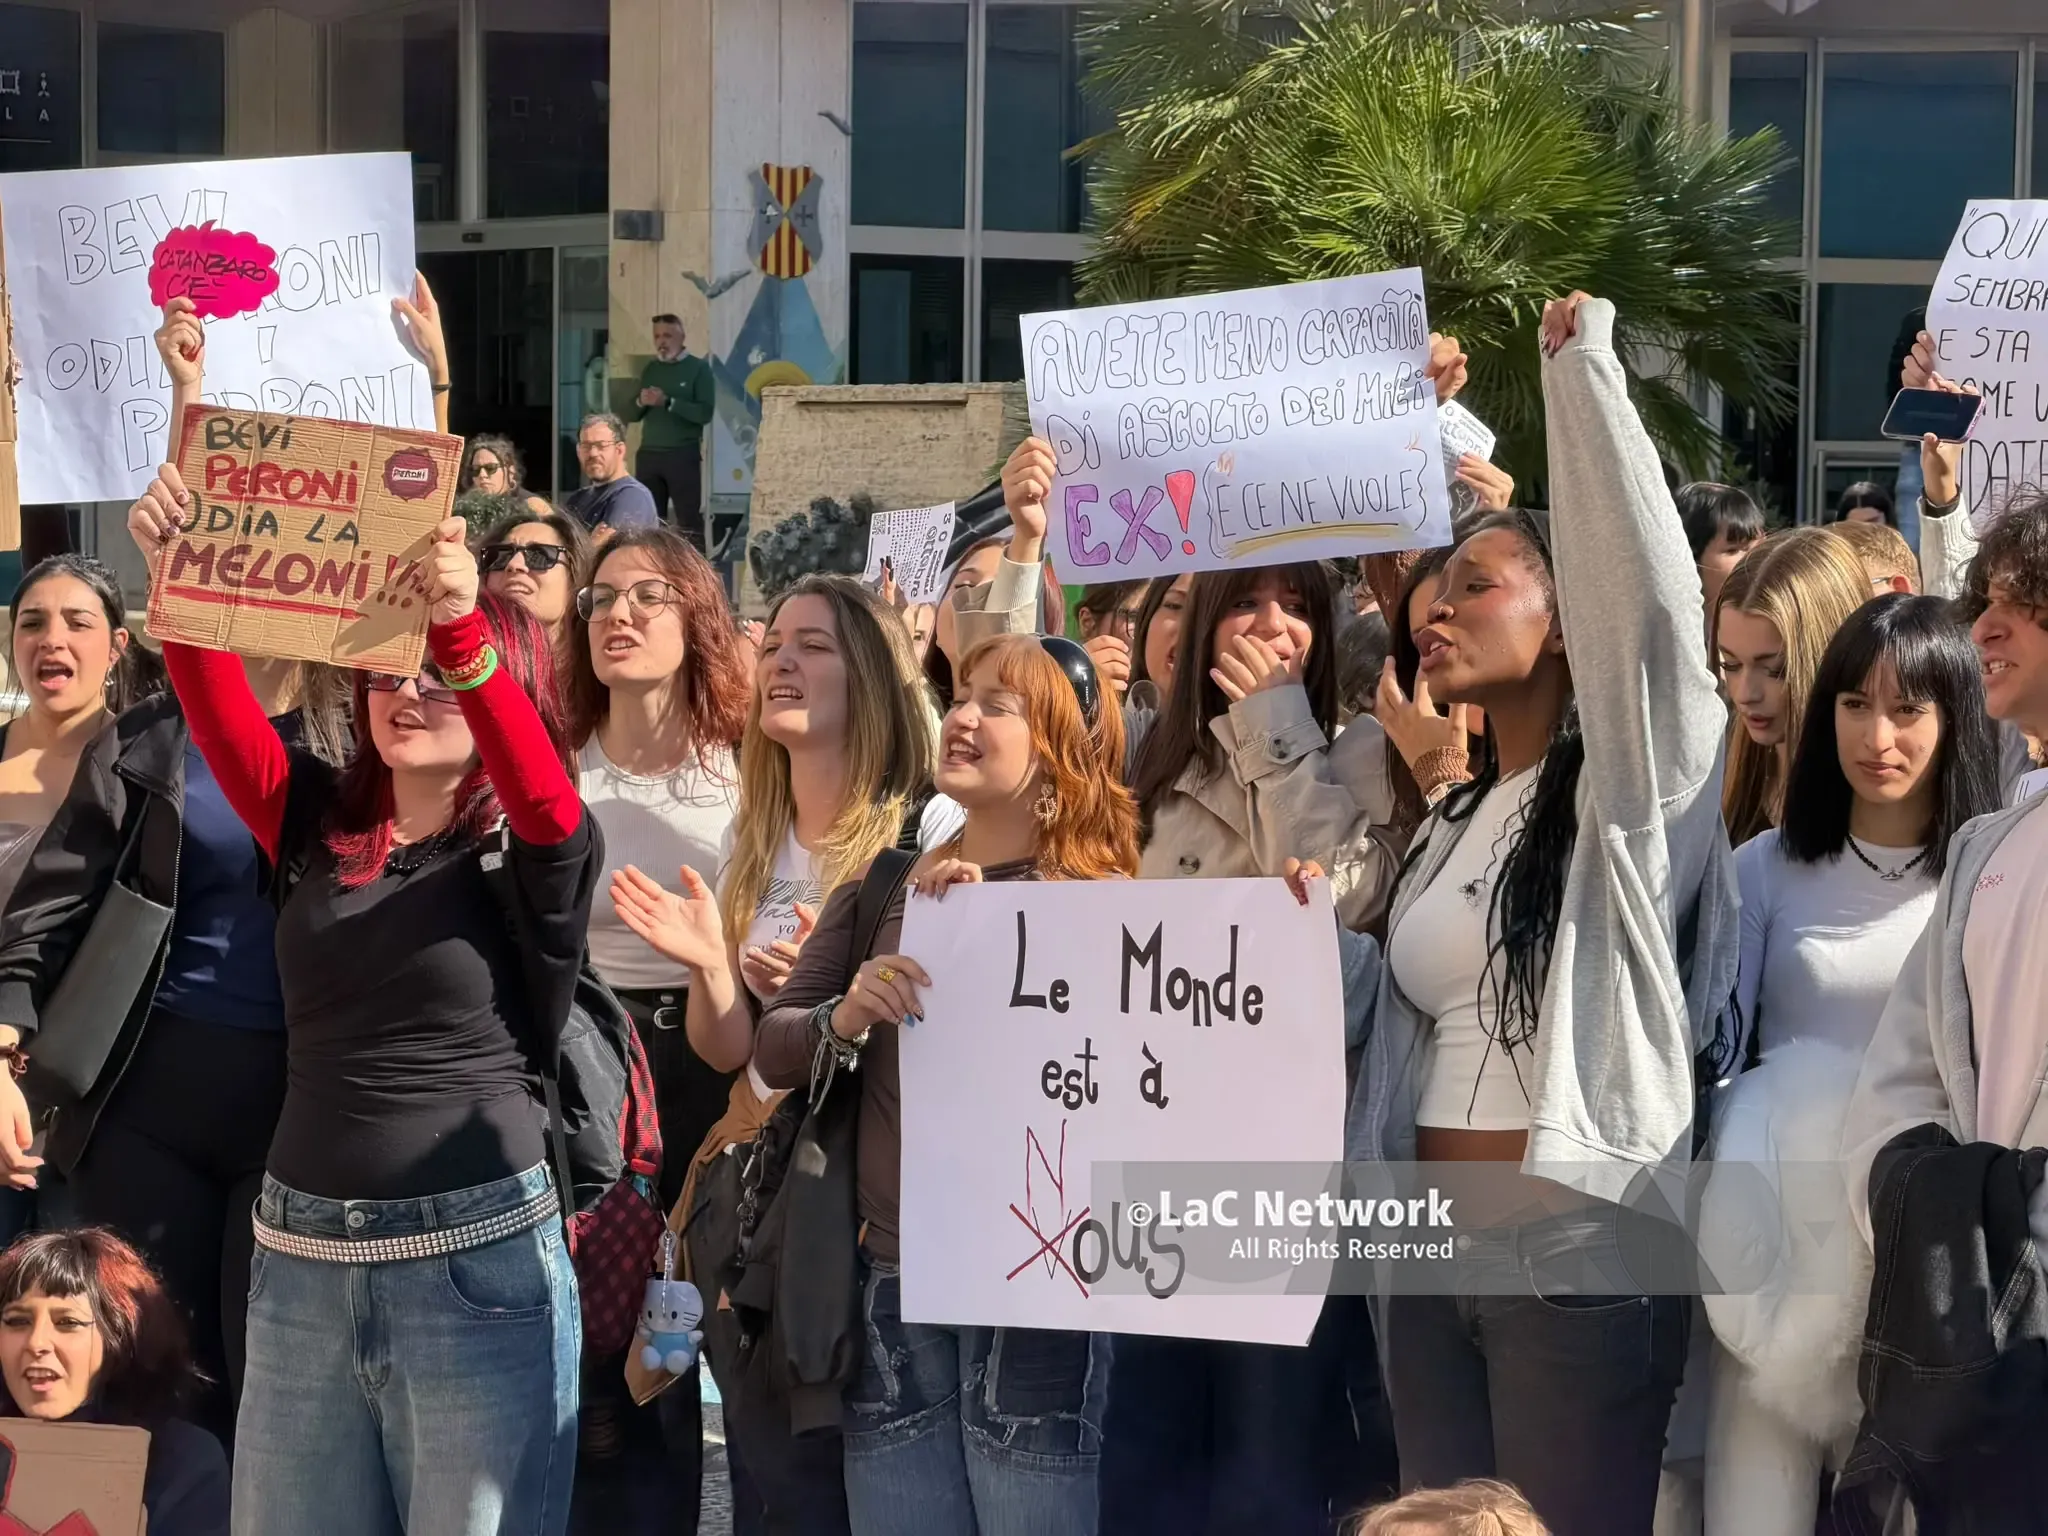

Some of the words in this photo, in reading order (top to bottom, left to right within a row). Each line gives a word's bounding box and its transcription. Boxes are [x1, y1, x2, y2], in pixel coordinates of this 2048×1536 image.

[158, 248, 268, 282] CATANZARO
[1030, 311, 1187, 402] AVETE
[1193, 310, 1290, 385] MENO
[1938, 328, 1958, 361] E
[1969, 326, 2030, 363] STA
[1117, 391, 1269, 460] ASCOLTO
[303, 513, 360, 549] LA
[1064, 468, 1197, 567] EX!
[1008, 910, 1070, 1014] Le
[1120, 919, 1264, 1027] Monde
[1041, 1036, 1099, 1111] est
[1139, 1041, 1170, 1110] à
